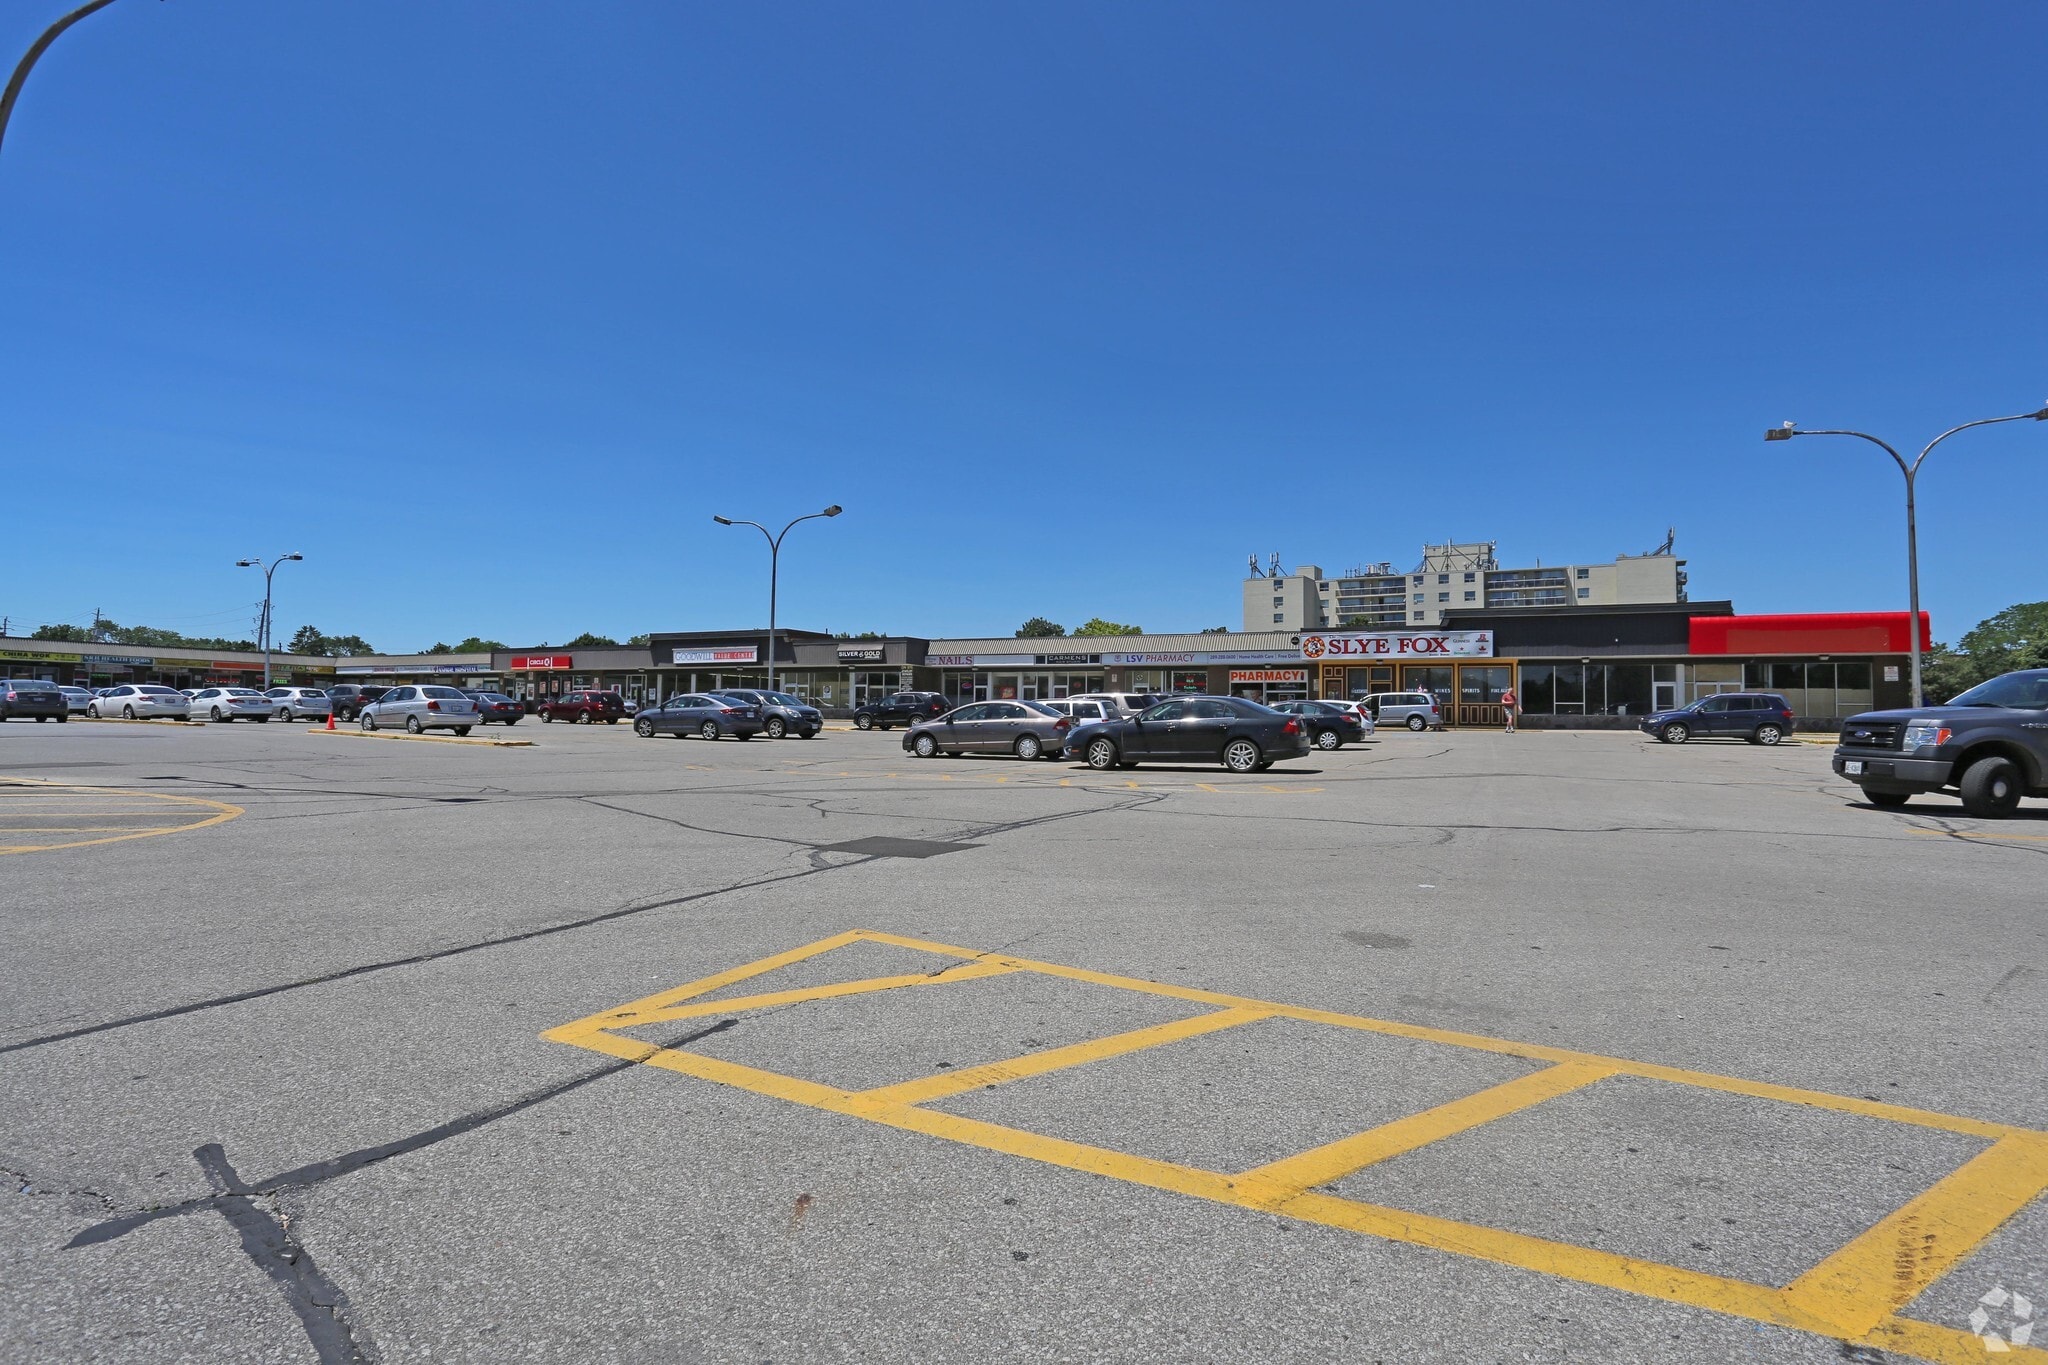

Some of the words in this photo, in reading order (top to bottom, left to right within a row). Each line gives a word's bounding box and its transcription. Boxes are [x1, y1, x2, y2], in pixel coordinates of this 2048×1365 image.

[1328, 639, 1390, 654] SLYE
[1397, 637, 1450, 653] FOX
[676, 651, 713, 661] GOODWILL
[938, 656, 973, 665] NAILS
[1146, 654, 1195, 662] PHARMACY
[1231, 671, 1300, 681] PHARMACY
